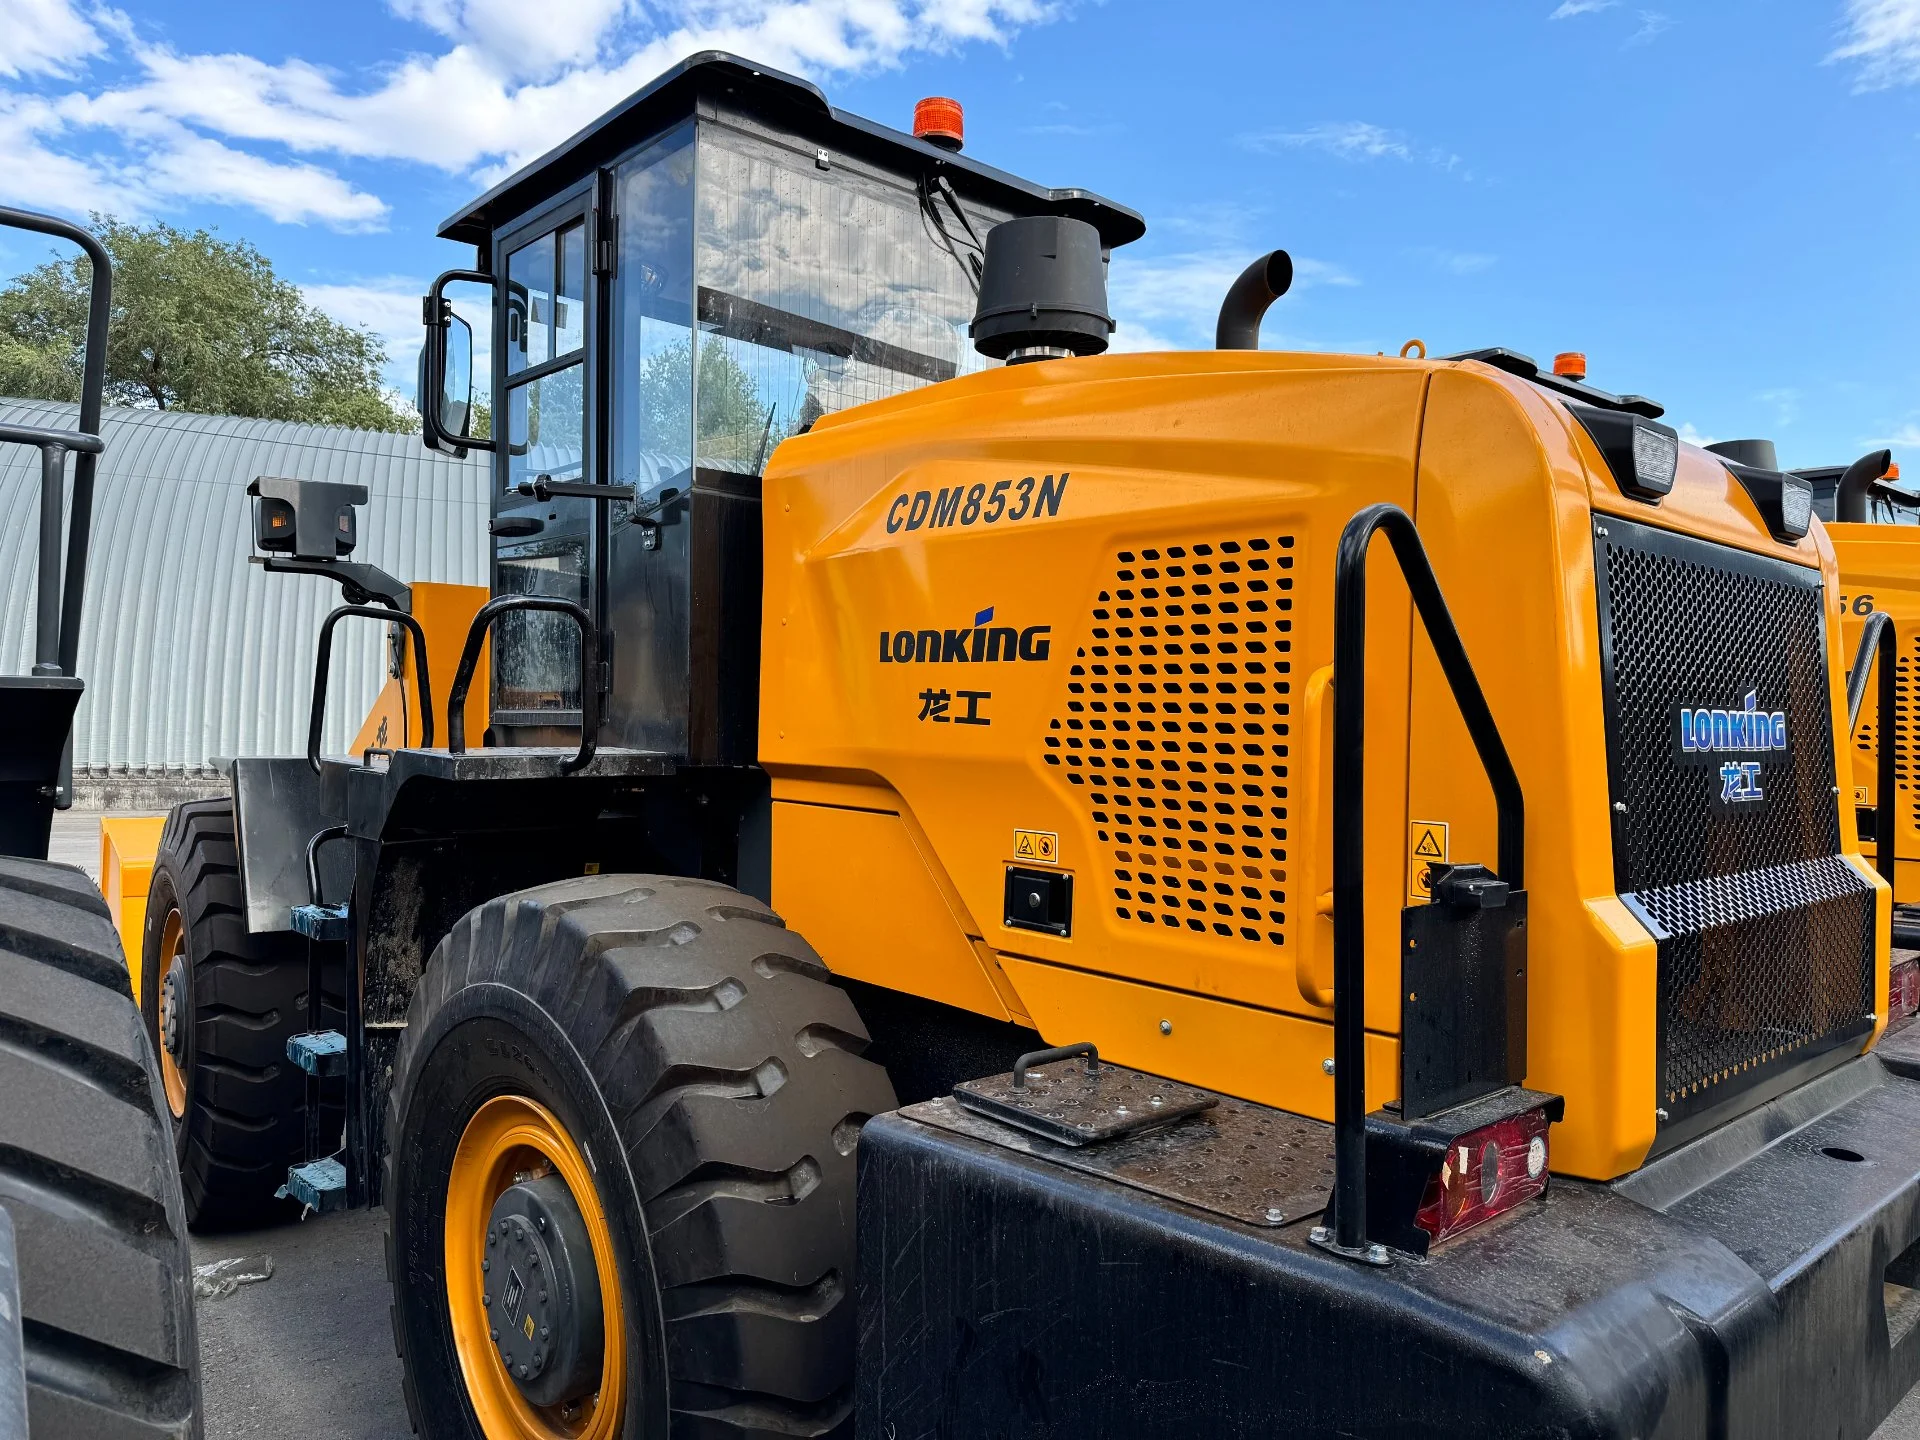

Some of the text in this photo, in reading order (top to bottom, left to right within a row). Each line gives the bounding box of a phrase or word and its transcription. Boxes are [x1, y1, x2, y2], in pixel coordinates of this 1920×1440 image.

[887, 473, 1070, 534] CDM853N
[879, 606, 1051, 663] LONKING
[917, 688, 992, 726] 龙工
[1680, 690, 1787, 752] LONKING
[1719, 761, 1764, 803] 龙工
